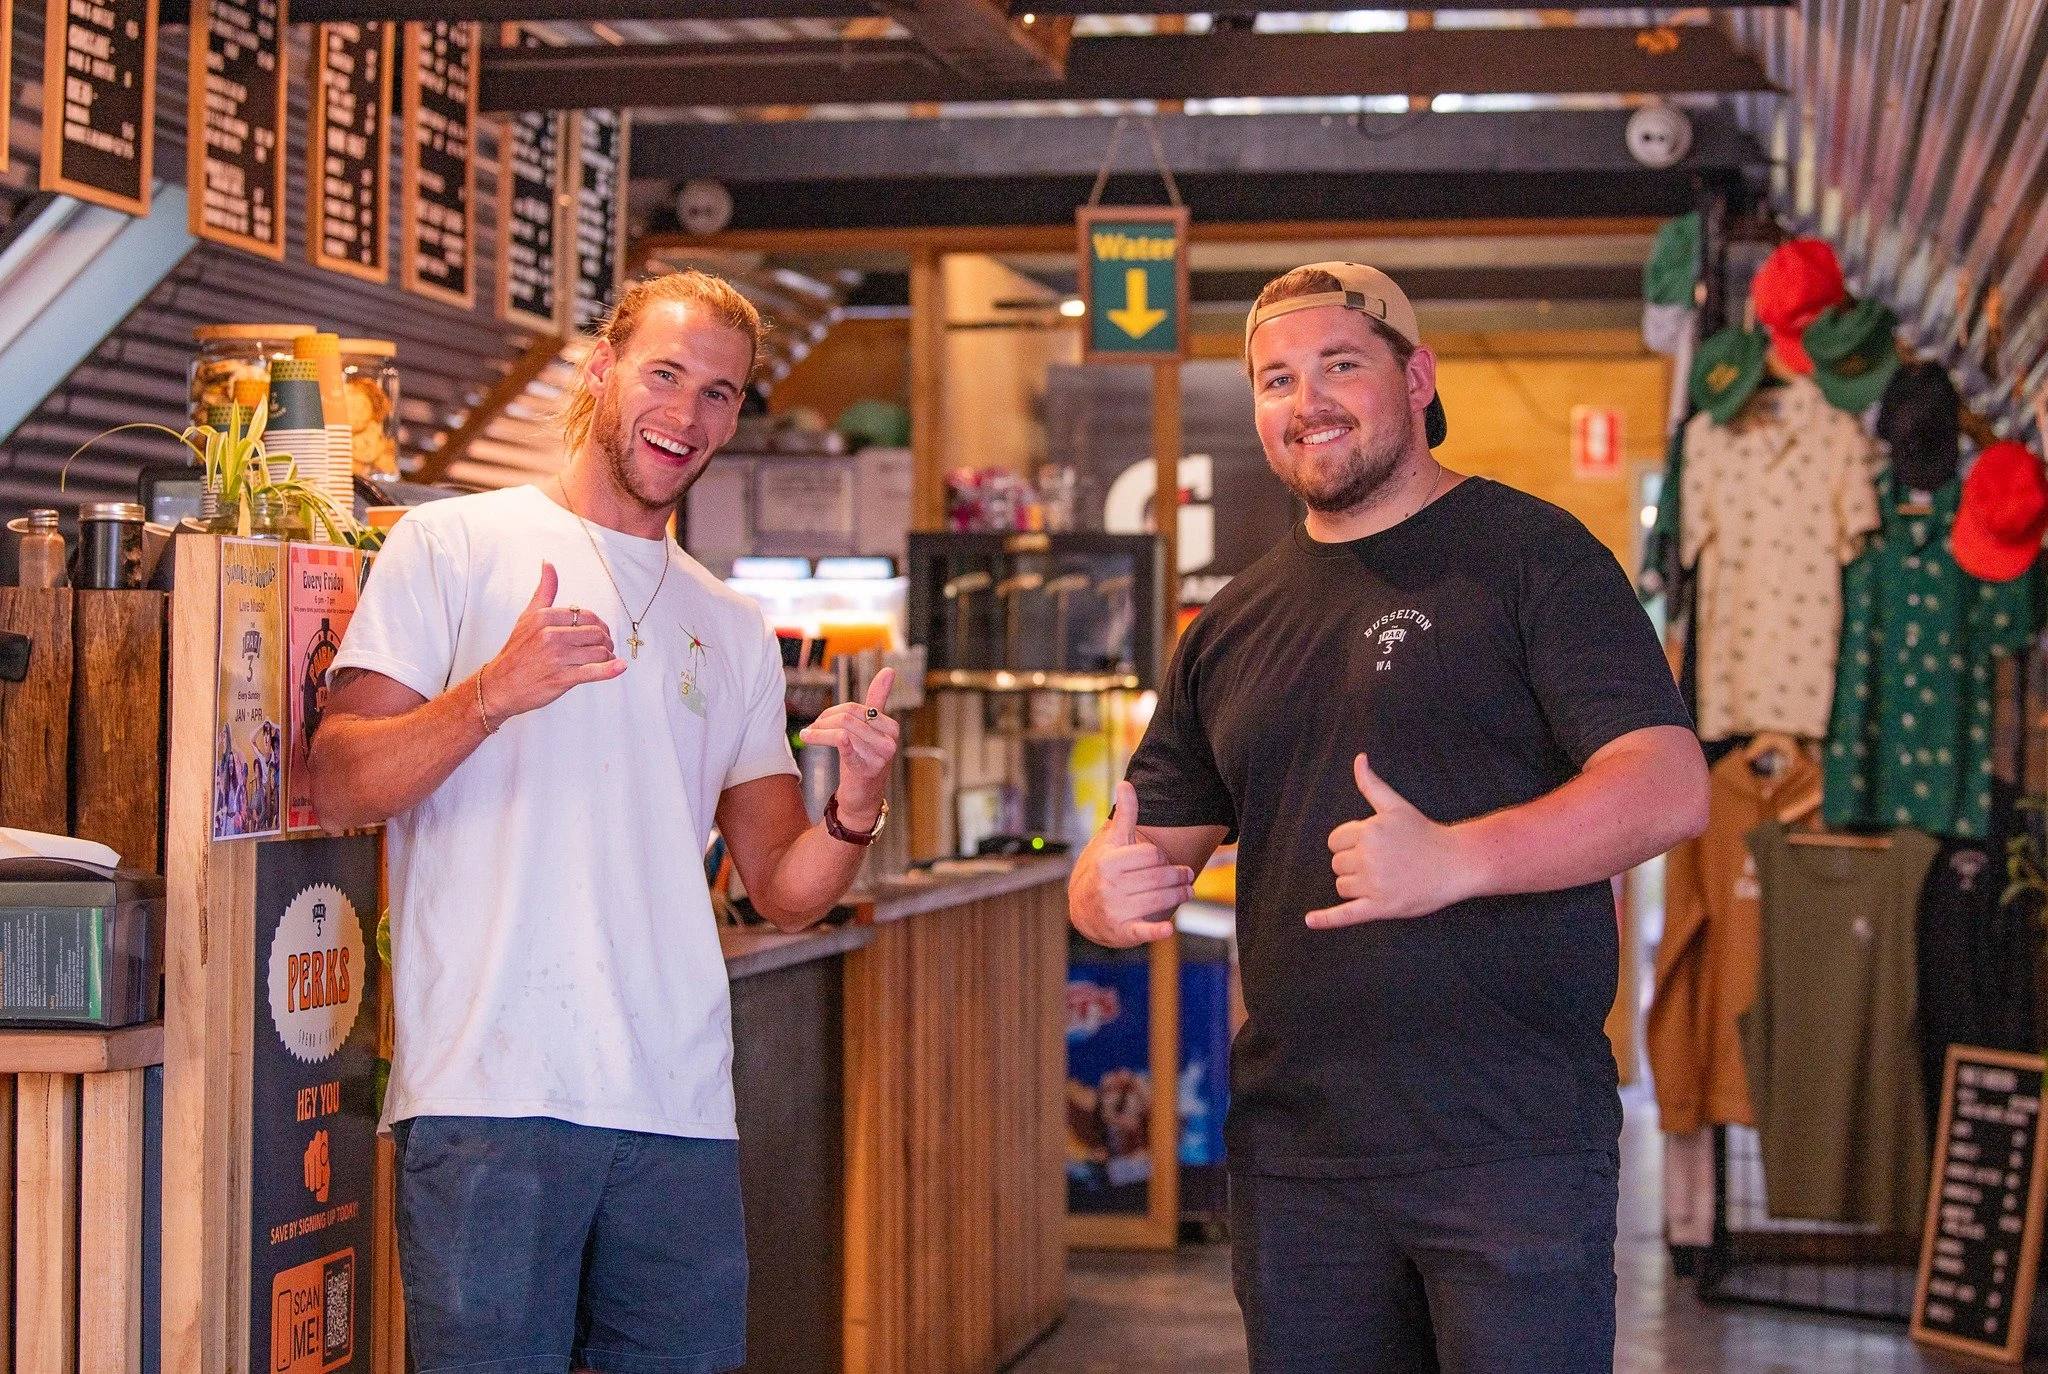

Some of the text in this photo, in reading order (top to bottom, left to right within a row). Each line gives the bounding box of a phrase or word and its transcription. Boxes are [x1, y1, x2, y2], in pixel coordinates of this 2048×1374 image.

[1092, 232, 1177, 260] Water
[303, 571, 344, 594] Every Friday
[238, 598, 266, 613] Live Music
[1364, 609, 1432, 638] BUSSELTON
[245, 635, 258, 649] PAR
[1384, 631, 1401, 639] PAR
[1382, 640, 1395, 655] 3
[247, 655, 254, 682] 3
[1376, 660, 1392, 671] WA
[237, 691, 261, 702] Every Sunday
[682, 681, 690, 695] 3
[235, 709, 246, 722] JAN
[250, 708, 263, 721] APR
[317, 919, 322, 938] 3
[288, 946, 350, 1013] PERKS
[297, 1081, 340, 1121] HEY YOU
[270, 1222, 288, 1246] SAVE
[289, 1221, 298, 1239] BY
[298, 1212, 327, 1237] SIGNING
[327, 1210, 336, 1228] UP
[293, 1284, 320, 1316] SCAN
[292, 1317, 320, 1361] ME!
